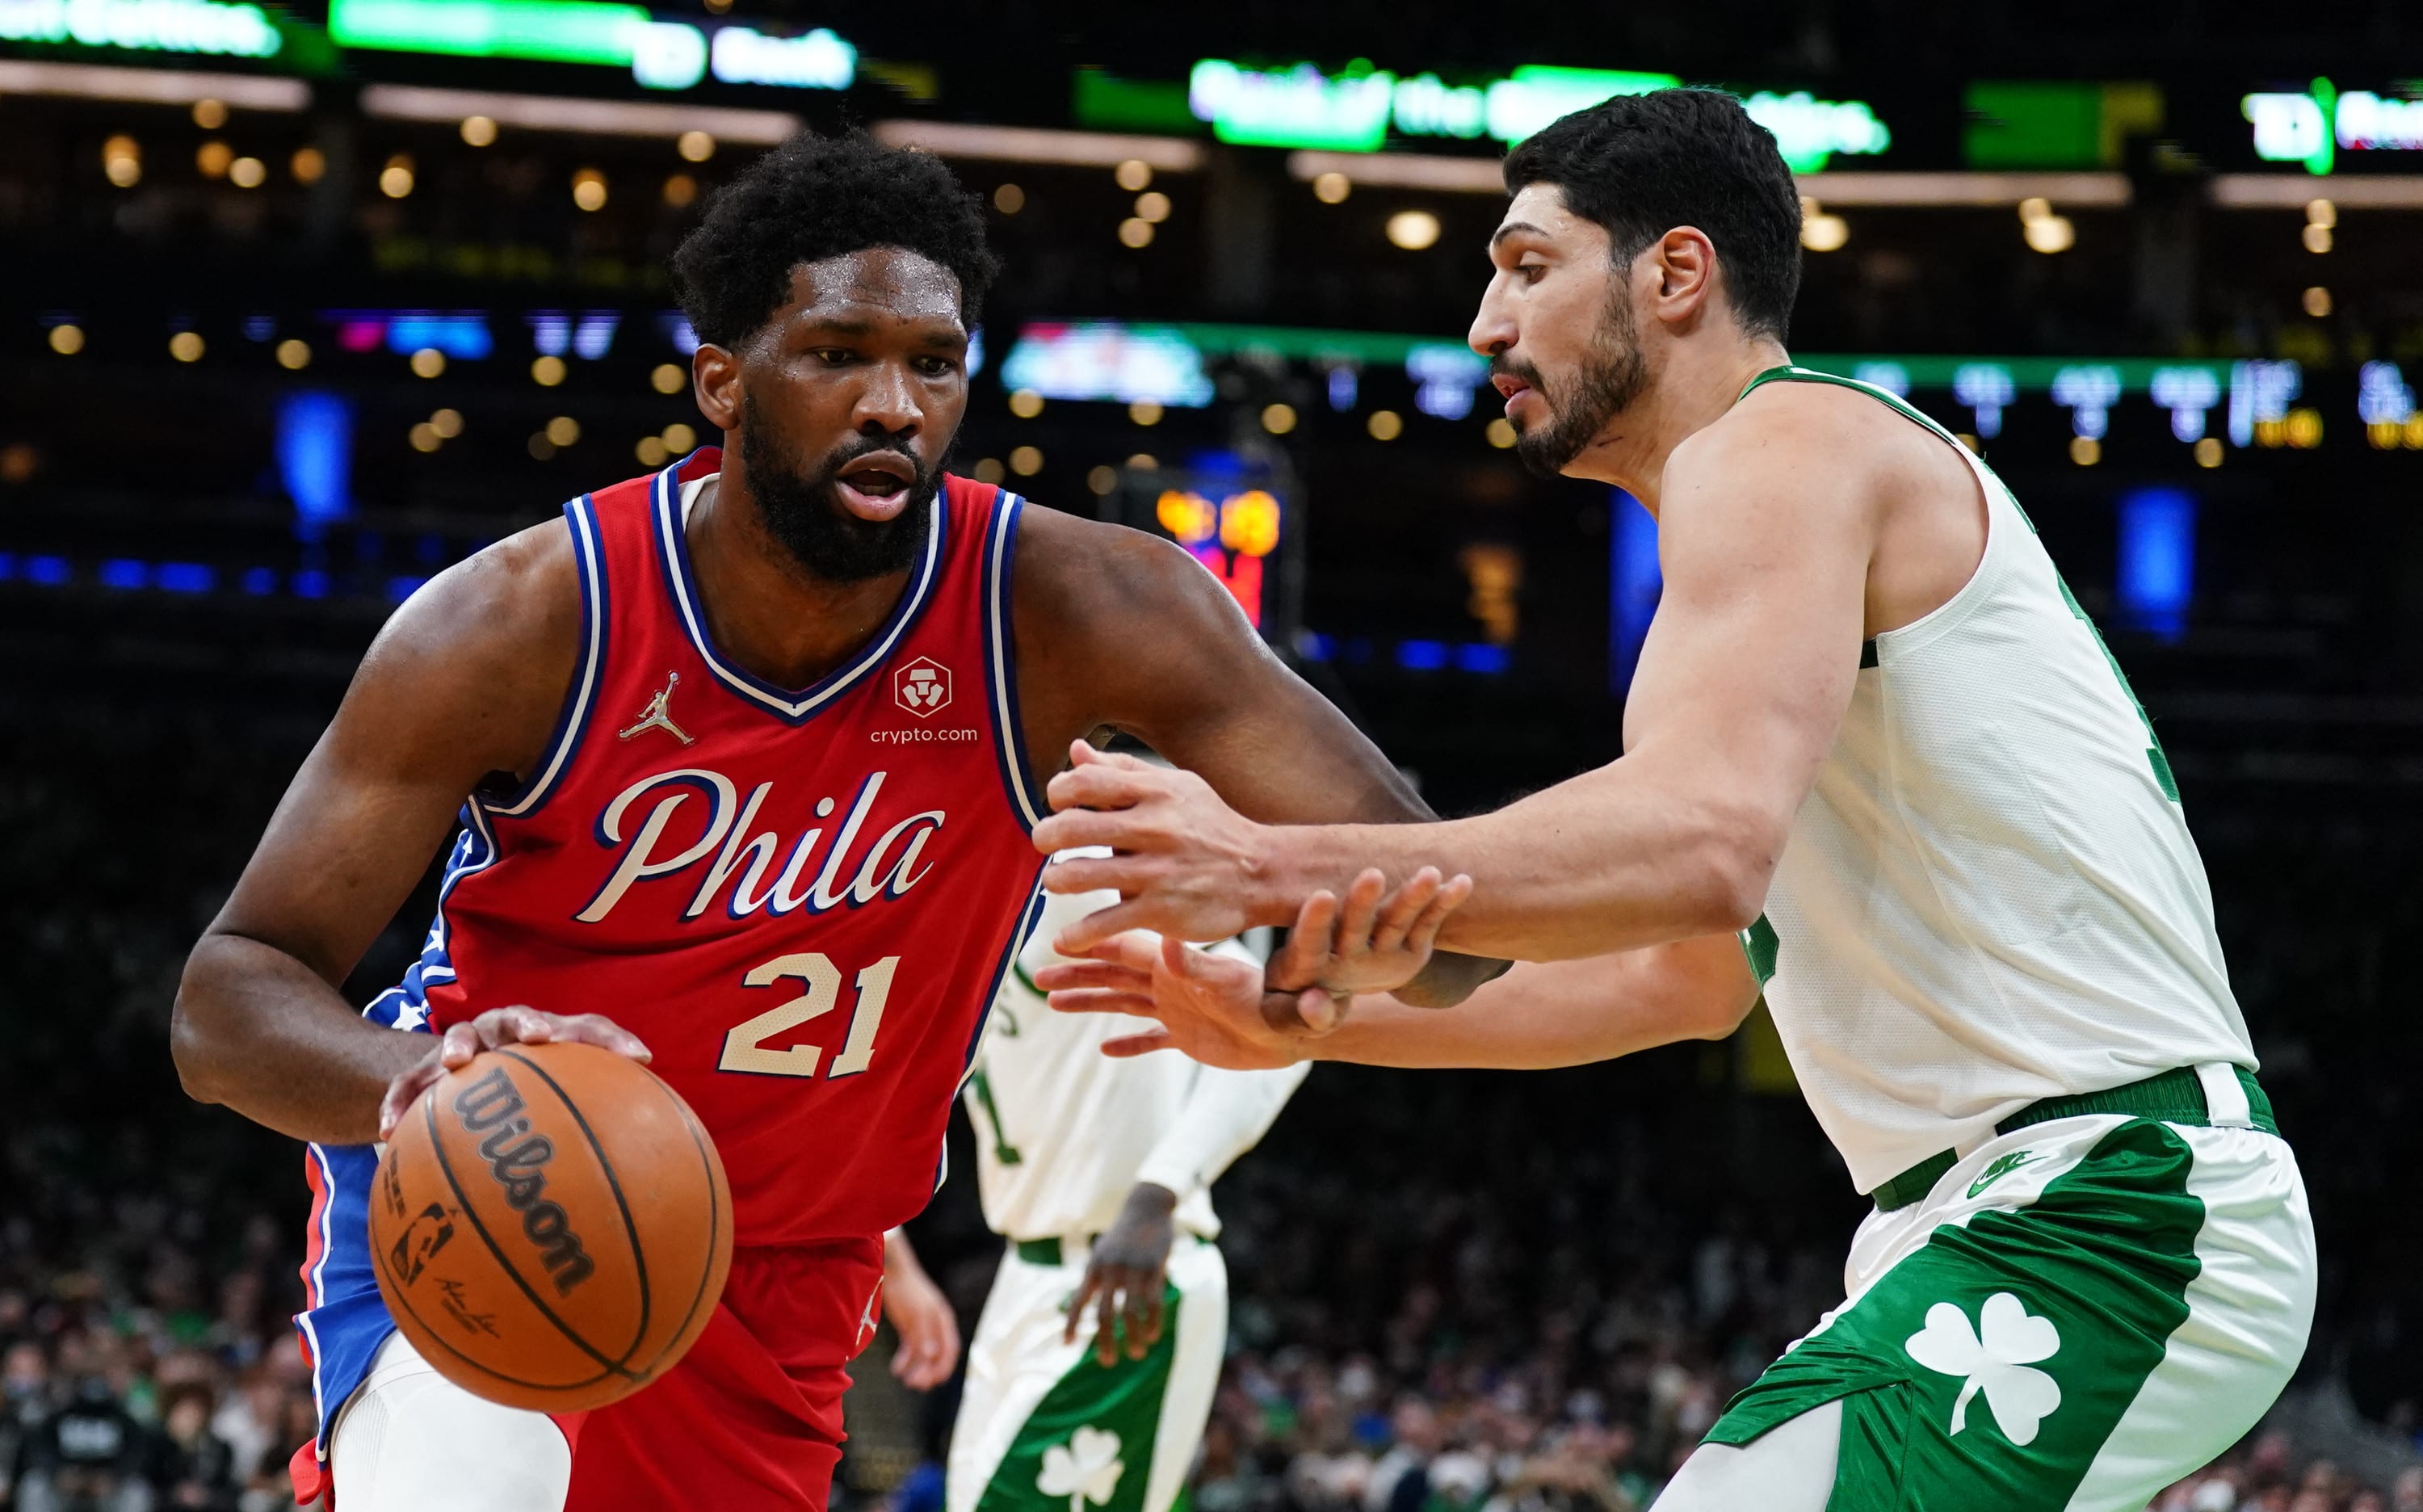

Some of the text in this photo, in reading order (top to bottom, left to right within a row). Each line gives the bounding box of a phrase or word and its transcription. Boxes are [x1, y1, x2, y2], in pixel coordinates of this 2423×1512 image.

[870, 726, 978, 746] crypto.com
[570, 767, 947, 924] Phila
[716, 951, 902, 1081] 21
[453, 1065, 595, 1300] Wilson
